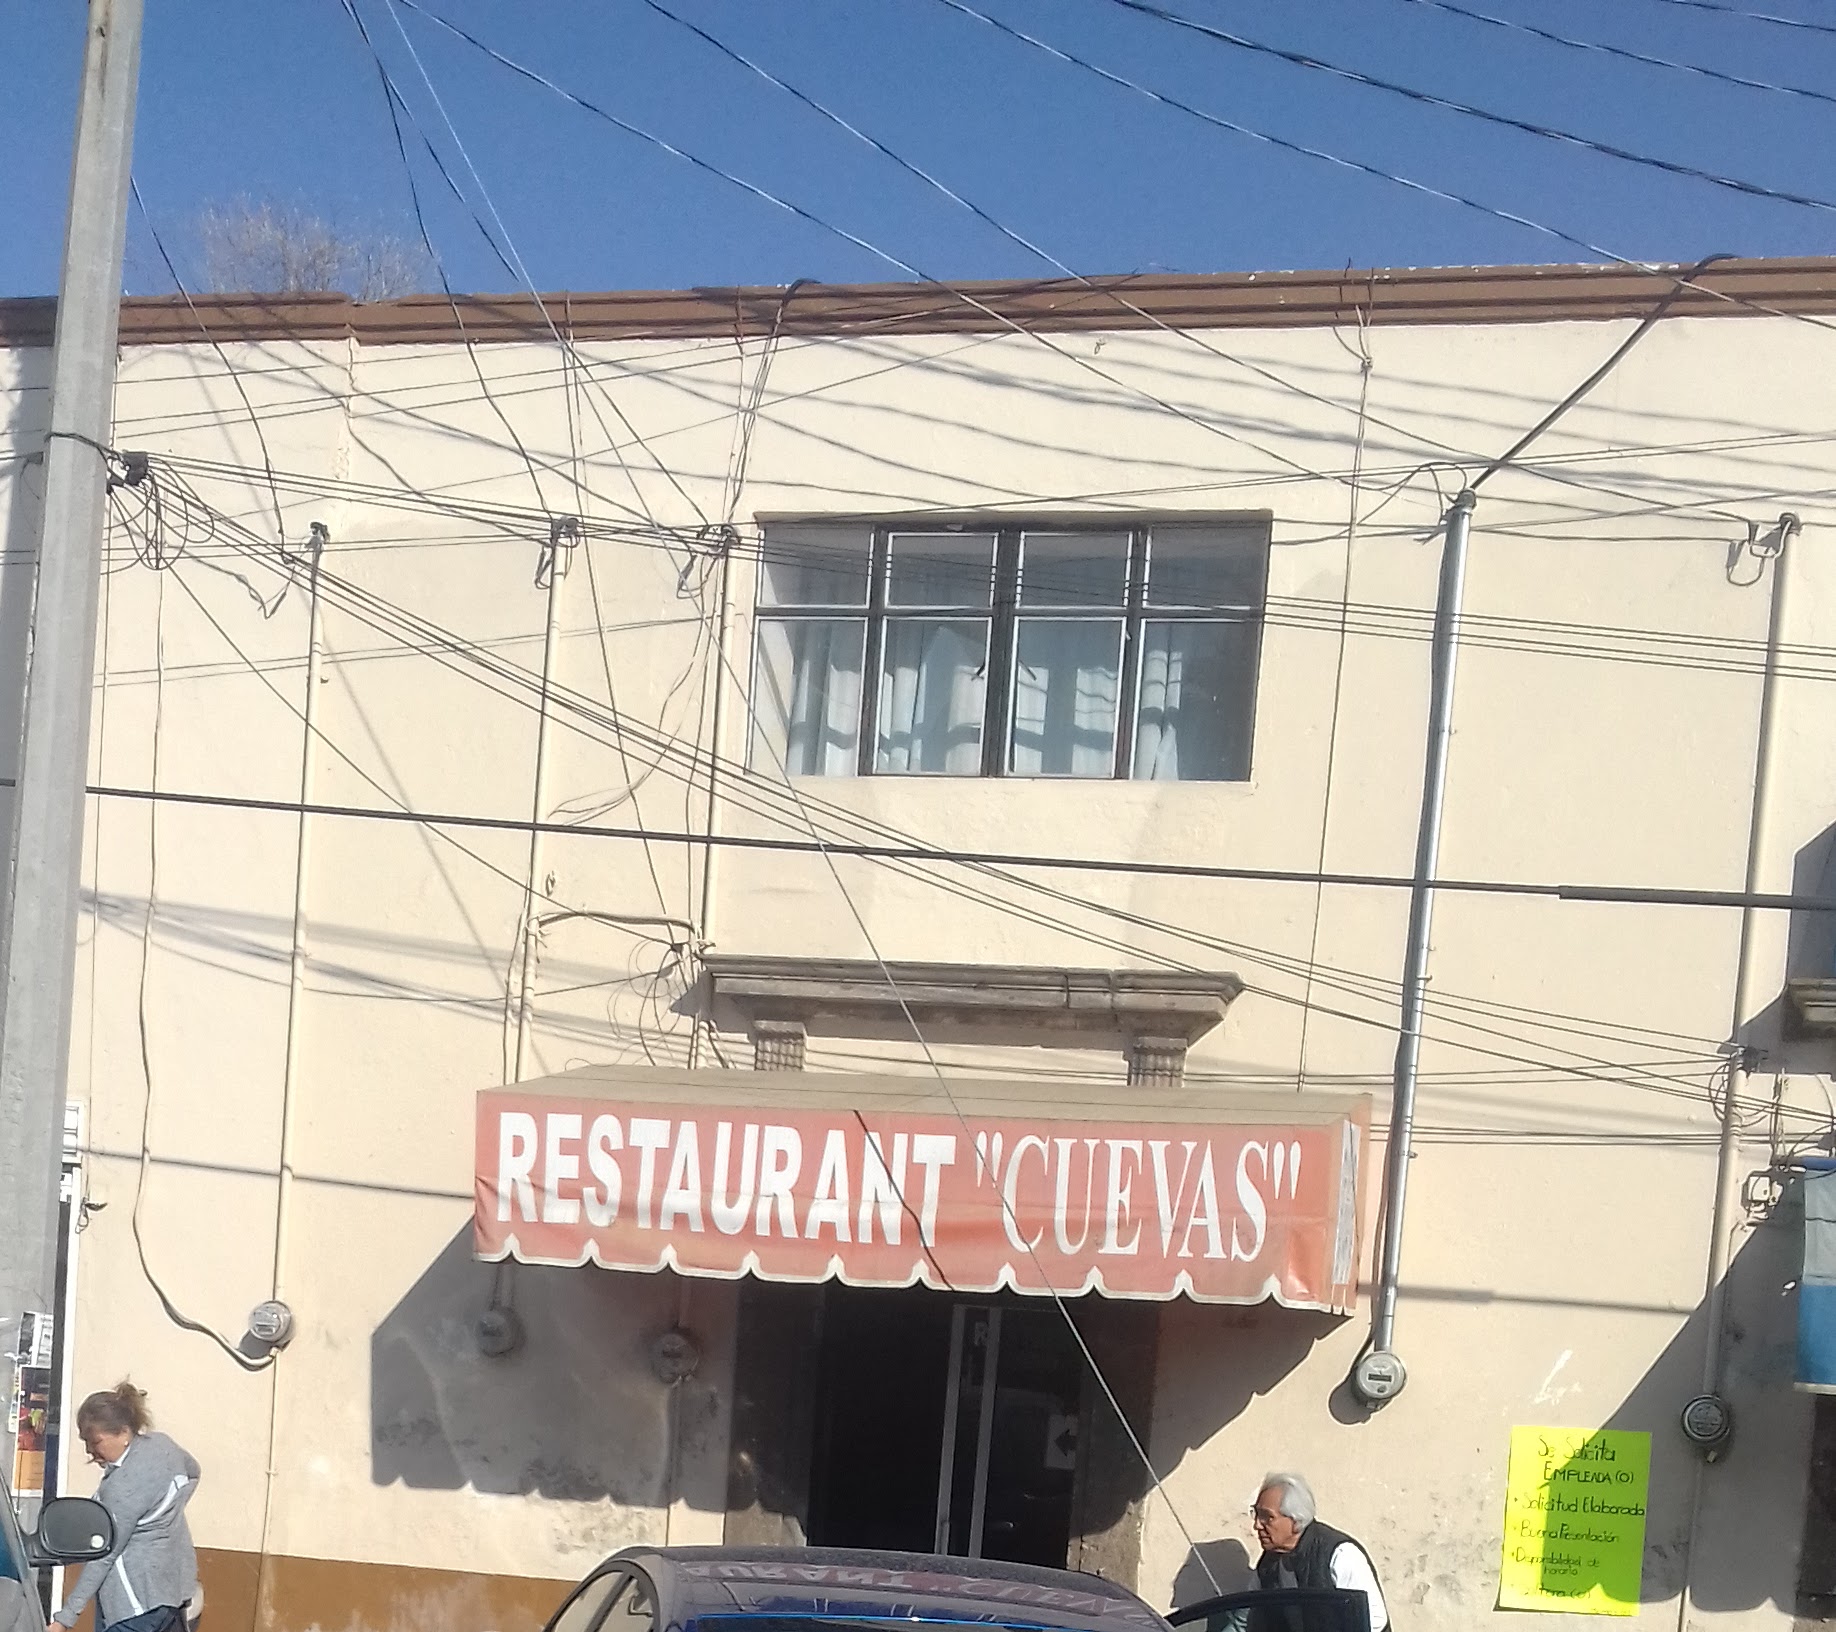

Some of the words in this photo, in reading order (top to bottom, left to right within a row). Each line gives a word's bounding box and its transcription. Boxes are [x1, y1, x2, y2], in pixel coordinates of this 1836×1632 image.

[497, 1111, 957, 1248] RESTAURANT
[976, 1126, 1303, 1263] "CUEVAS"
[1538, 1434, 1556, 1458] Se
[1563, 1436, 1616, 1462] Solicita
[1544, 1460, 1612, 1485] EMPLEADA
[1522, 1492, 1578, 1513] Solicitud
